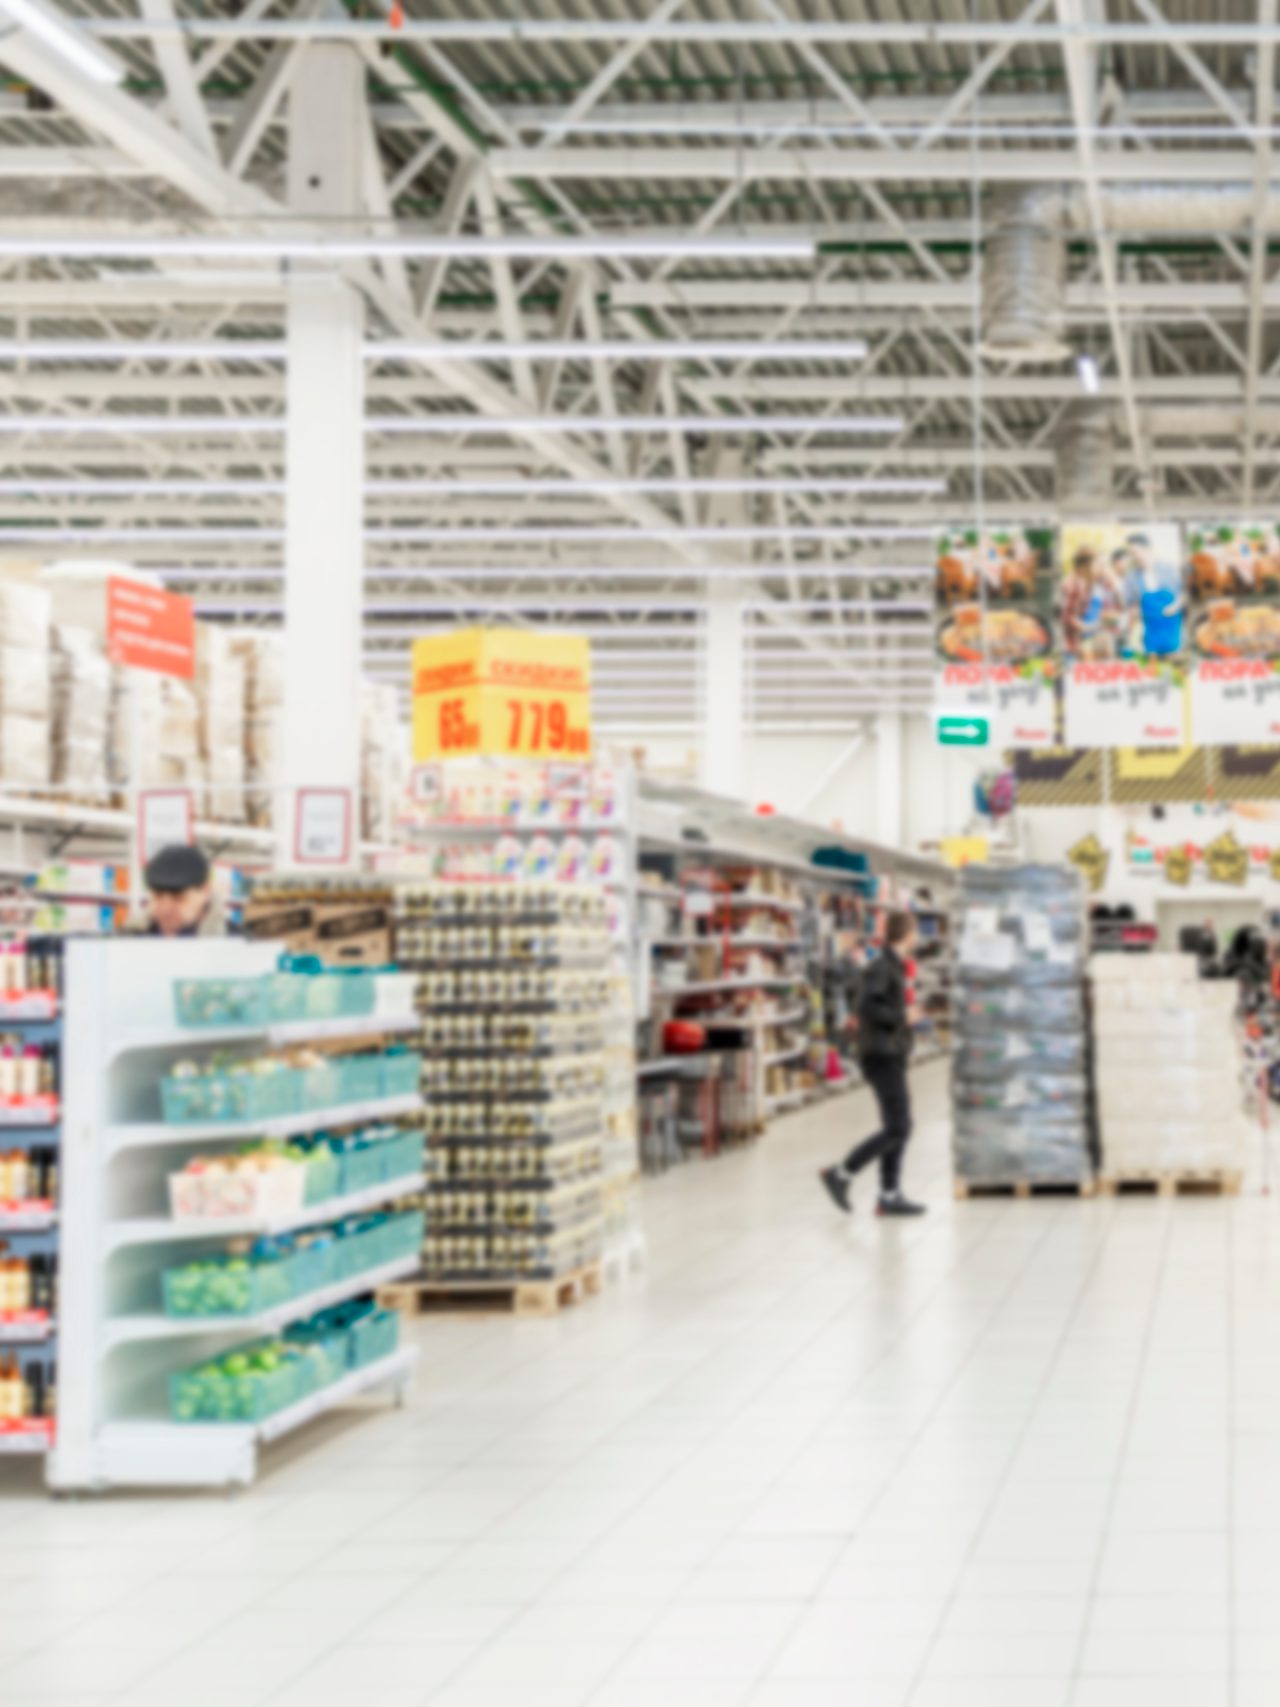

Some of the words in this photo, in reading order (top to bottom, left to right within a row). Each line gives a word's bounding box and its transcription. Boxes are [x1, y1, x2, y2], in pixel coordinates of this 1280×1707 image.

[1074, 662, 1145, 684] ПОРА
[1200, 660, 1269, 682] ПОРА
[507, 699, 567, 752] 779
